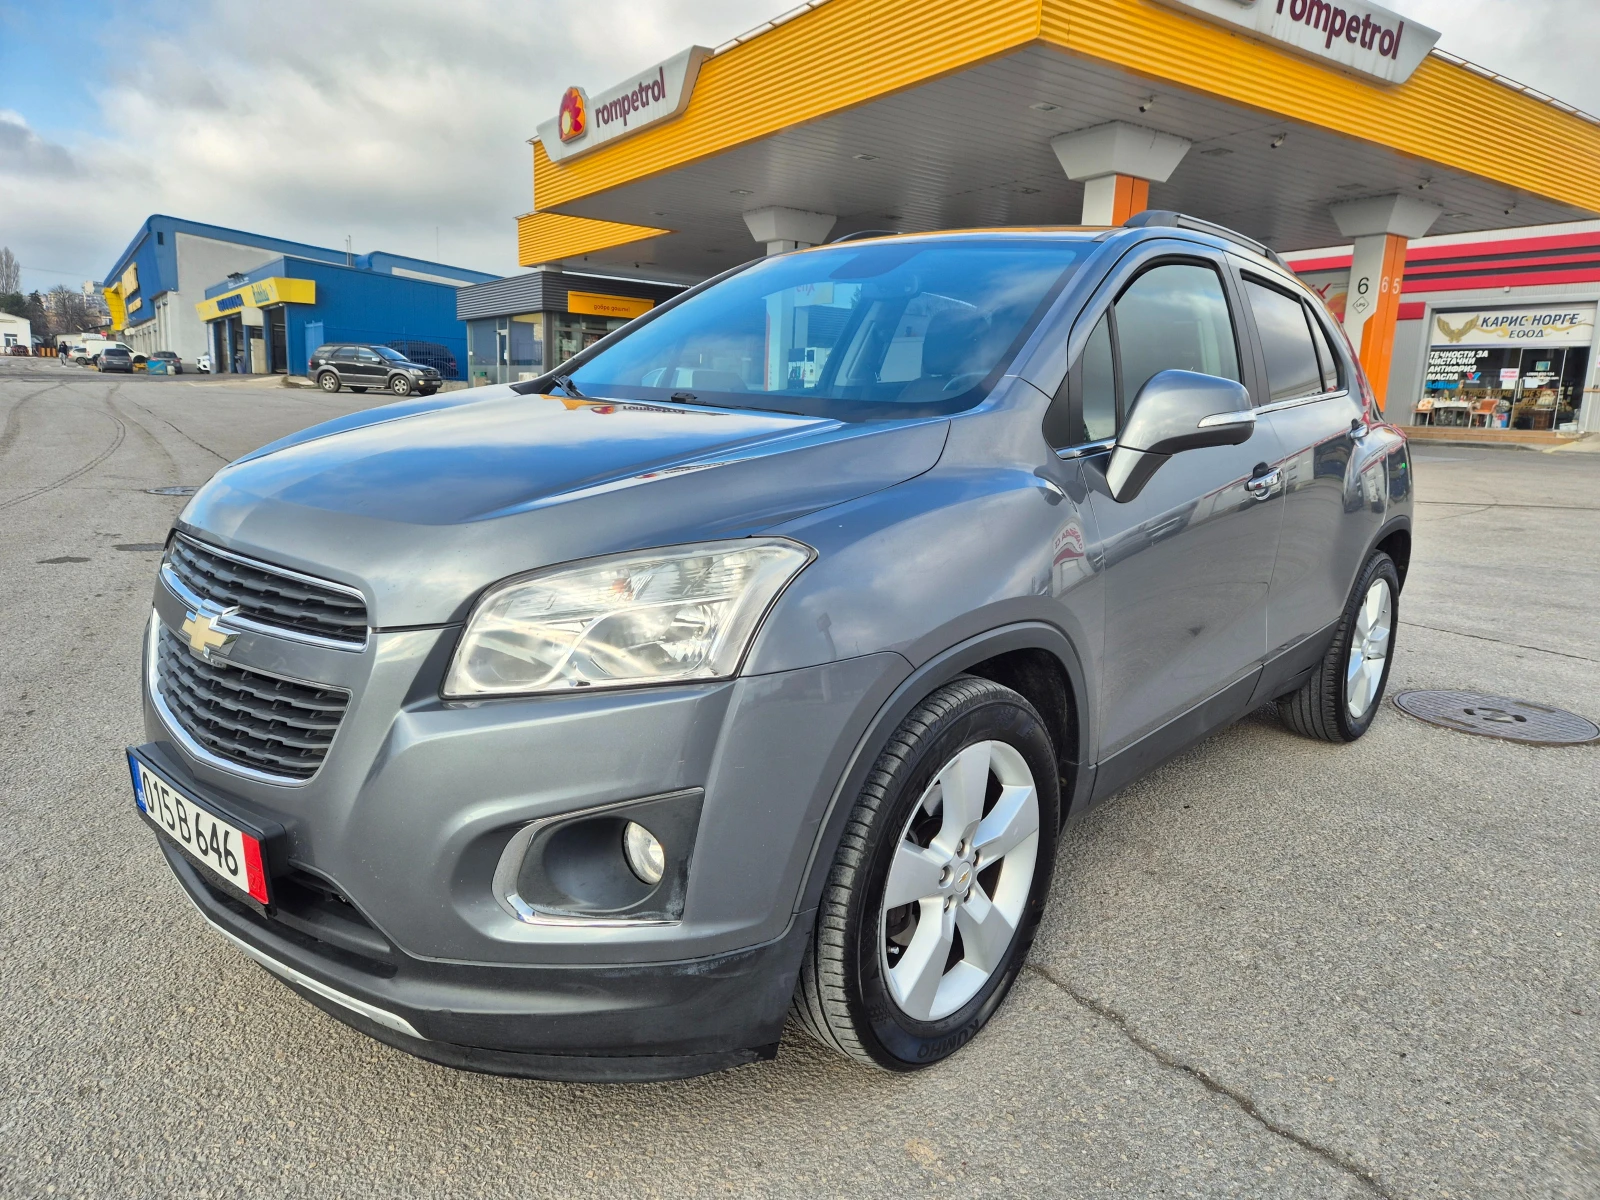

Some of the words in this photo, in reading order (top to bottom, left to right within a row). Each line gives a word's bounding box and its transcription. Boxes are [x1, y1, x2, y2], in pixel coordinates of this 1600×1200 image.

[595, 66, 666, 128] rompetrol
[1357, 276, 1370, 295] 6
[1381, 276, 1389, 293] 6
[1392, 277, 1401, 295] 5
[1480, 315, 1528, 327] КАРИС
[1531, 313, 1580, 326] НОРГЕ
[1508, 329, 1545, 339] ЕООД
[1430, 350, 1475, 359] ТЕЧНОСТИ
[1475, 350, 1489, 358] ЗА
[1426, 372, 1459, 381] МАСЛА
[1427, 365, 1477, 373] АНТИФРИЗ
[917, 1018, 980, 1059] KUMHO
